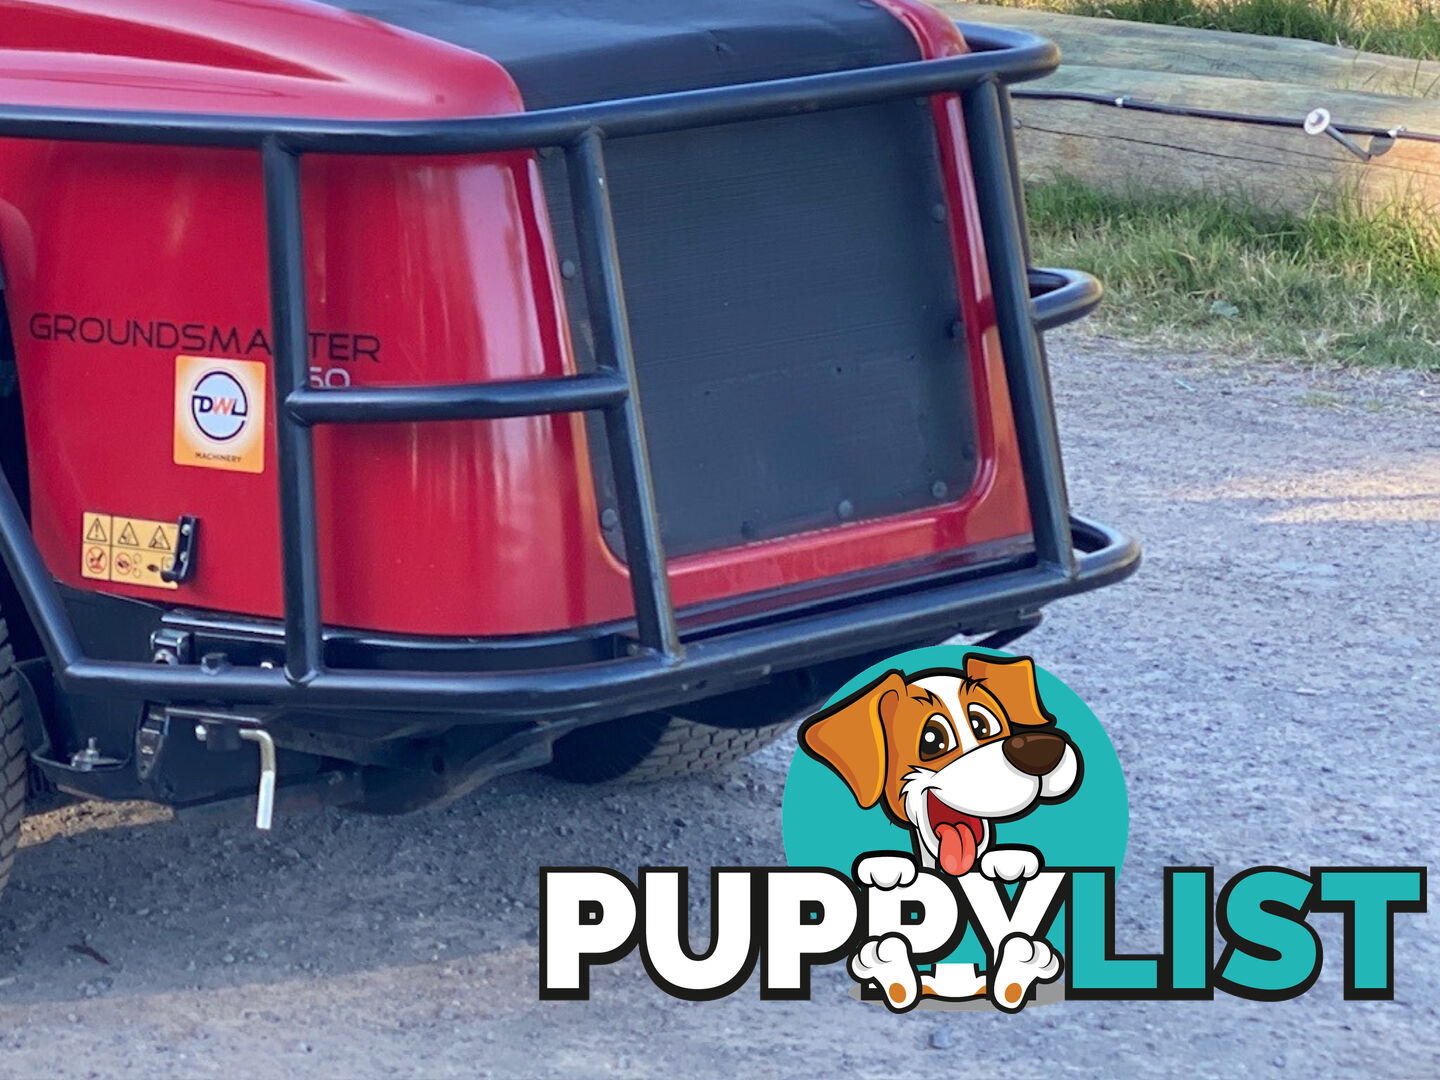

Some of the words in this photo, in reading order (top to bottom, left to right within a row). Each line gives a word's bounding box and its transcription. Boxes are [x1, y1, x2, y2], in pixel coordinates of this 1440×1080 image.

[29, 312, 381, 362] GROUNDSMATER
[193, 394, 247, 416] DWL
[195, 451, 242, 463] MACHINERY
